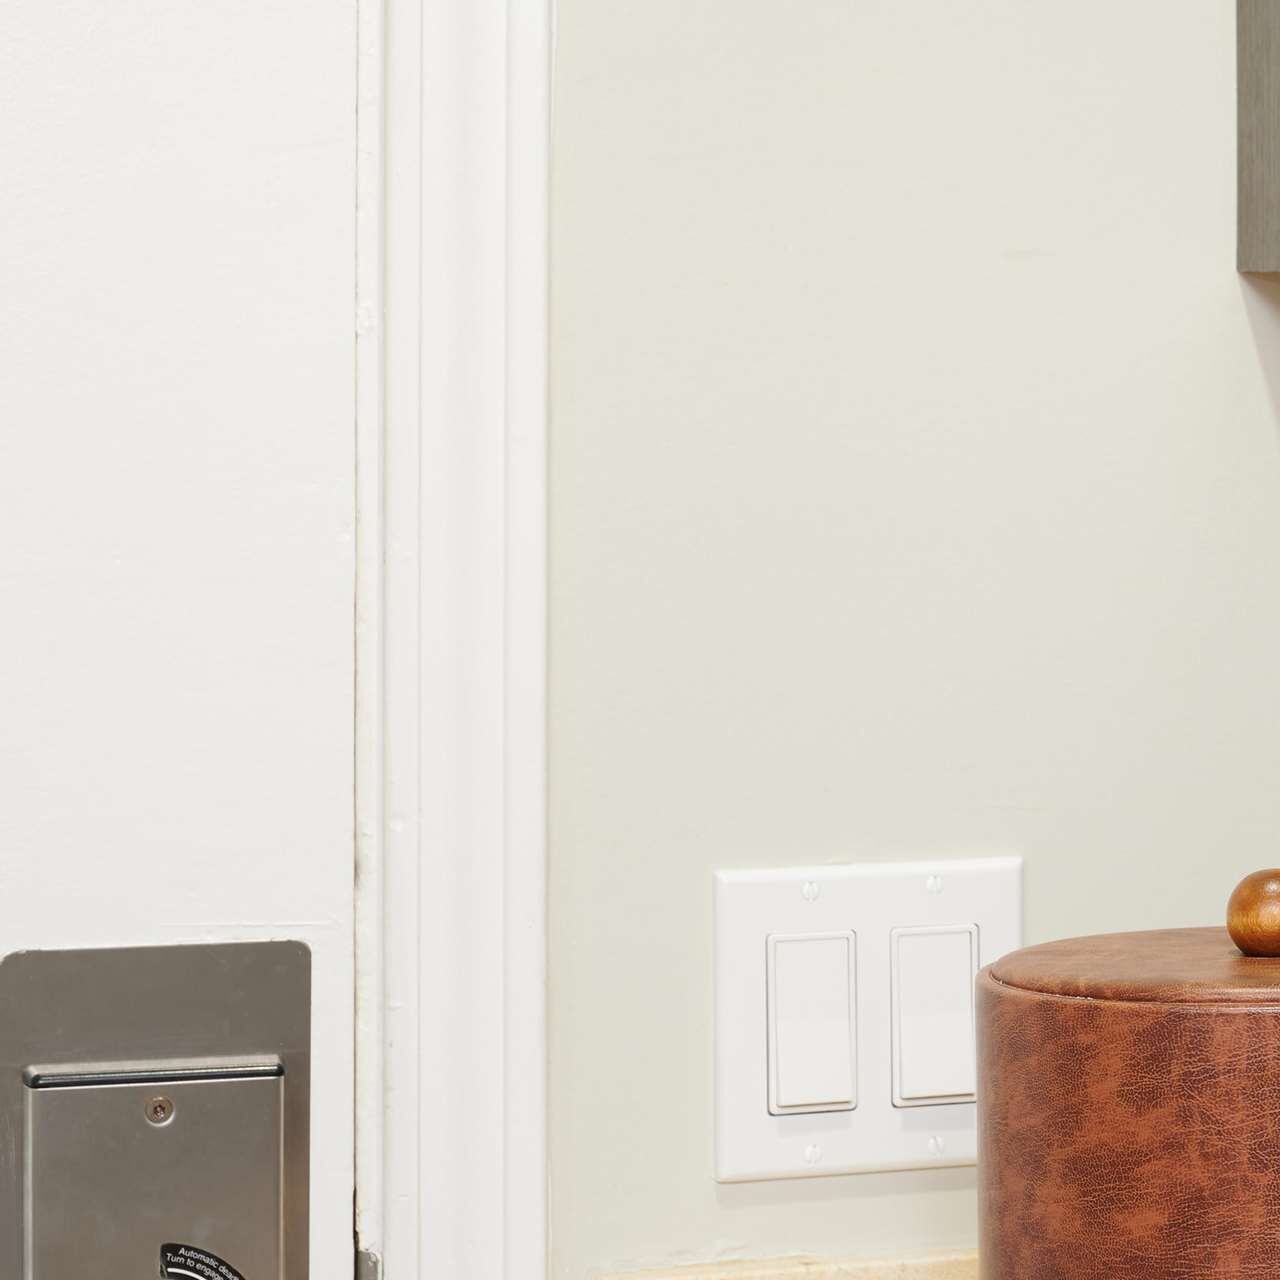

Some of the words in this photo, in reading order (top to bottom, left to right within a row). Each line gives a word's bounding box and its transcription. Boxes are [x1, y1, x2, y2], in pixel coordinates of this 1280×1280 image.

[166, 1252, 186, 1265] Turn
[186, 1258, 196, 1268] to
[178, 1246, 219, 1269] Automatic
